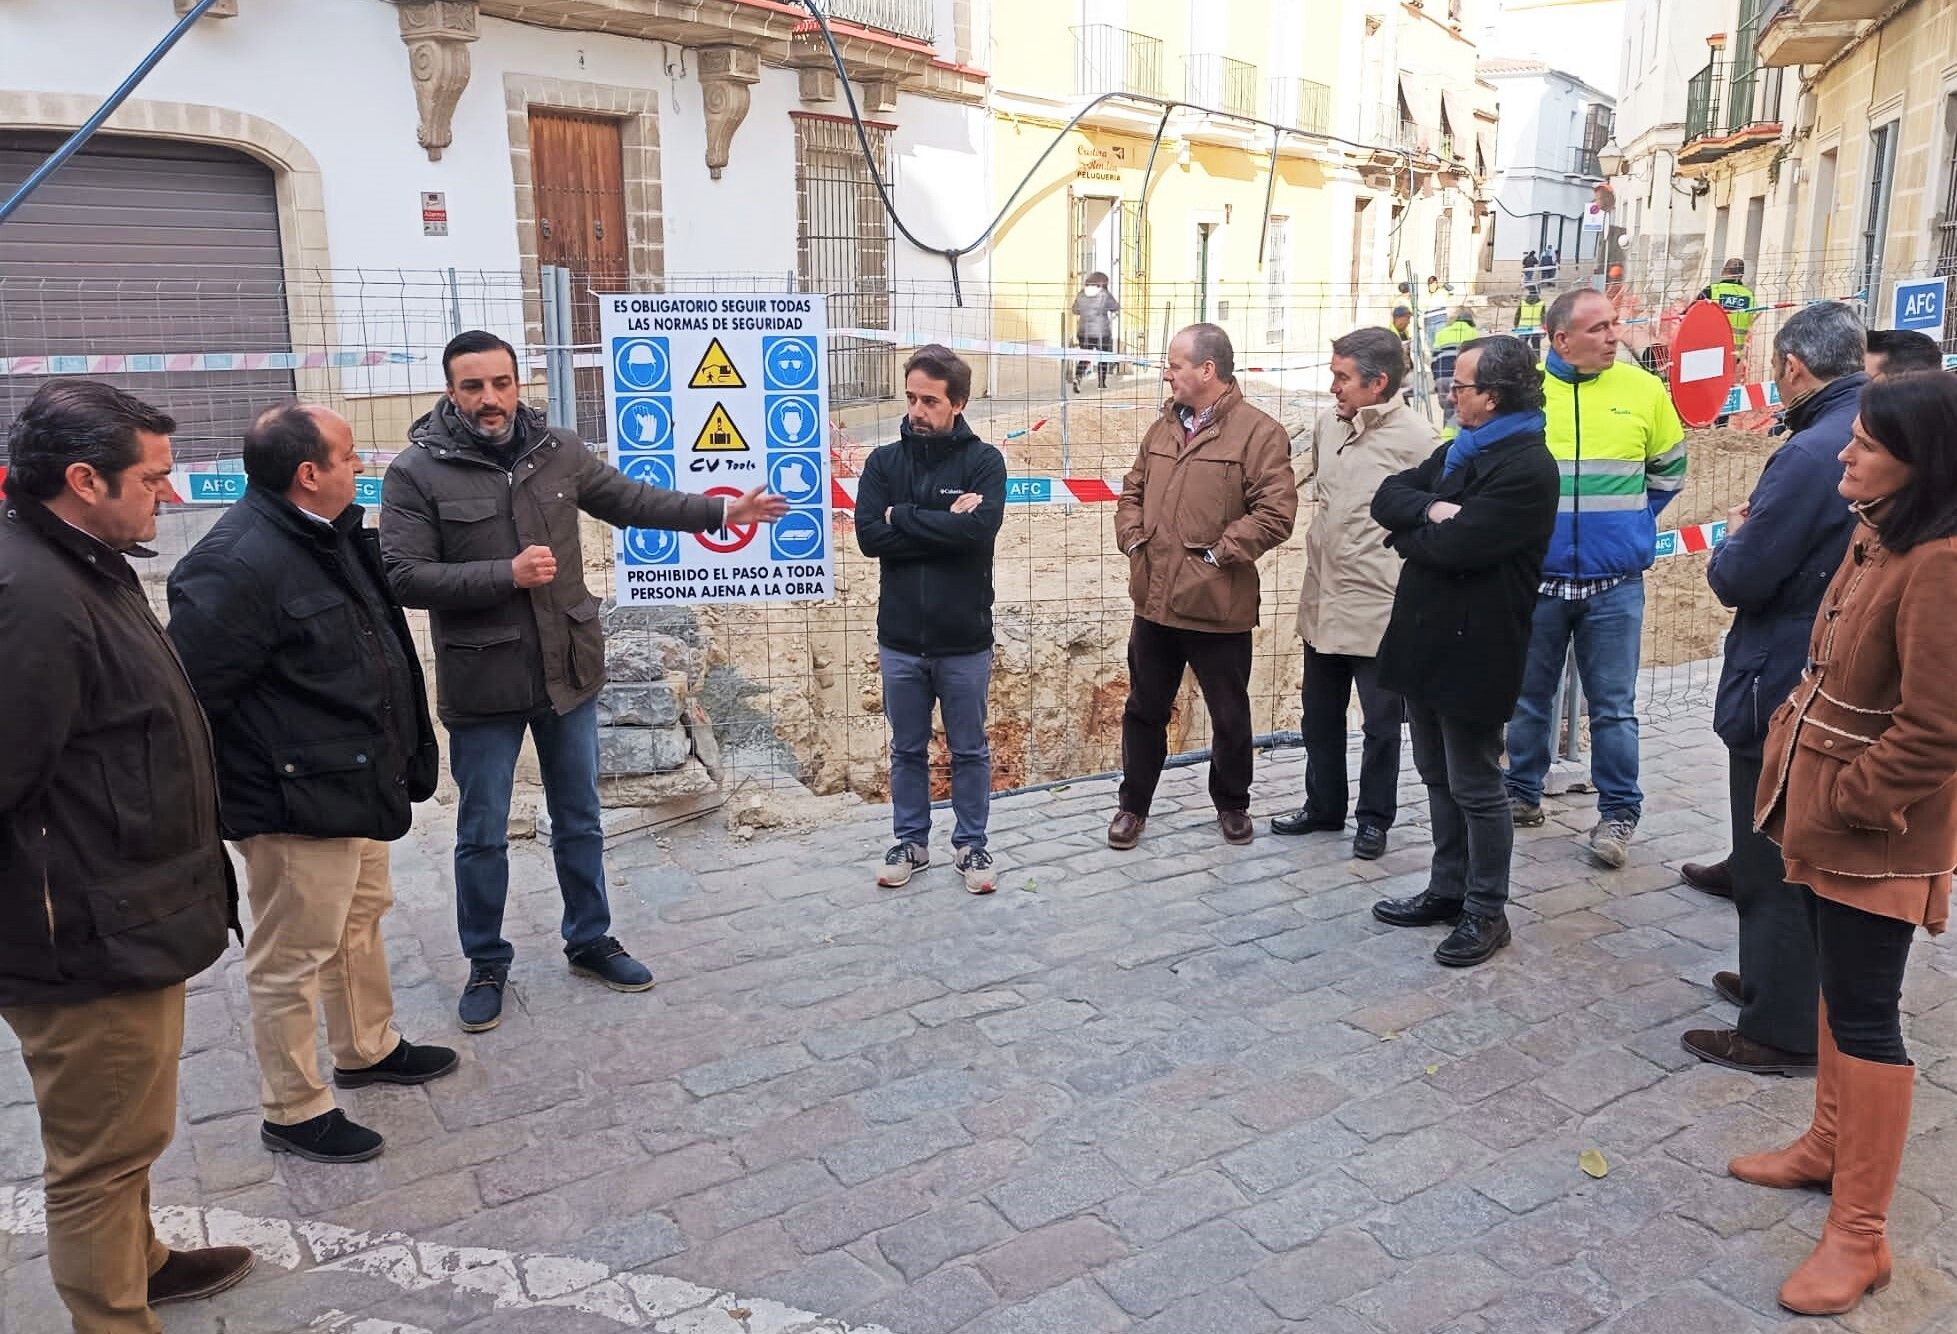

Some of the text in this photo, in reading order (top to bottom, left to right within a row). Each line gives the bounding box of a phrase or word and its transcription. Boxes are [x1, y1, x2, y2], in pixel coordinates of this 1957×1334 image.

[614, 300, 811, 313] ES OBLIGATORIO SEGUIR TODAS
[1725, 296, 1745, 307] AFC
[1904, 291, 1936, 317] AFC
[628, 318, 803, 331] LAS NORMAS DE SEGURIDAD
[689, 458, 756, 473] CV Tools
[202, 480, 236, 492] AFC
[356, 483, 376, 495] FC
[1010, 482, 1041, 495] AFC
[627, 565, 825, 583] PROHIBIDO EL PASO A TODA
[631, 581, 824, 600] PERSONA AJENA A LA OBRA
